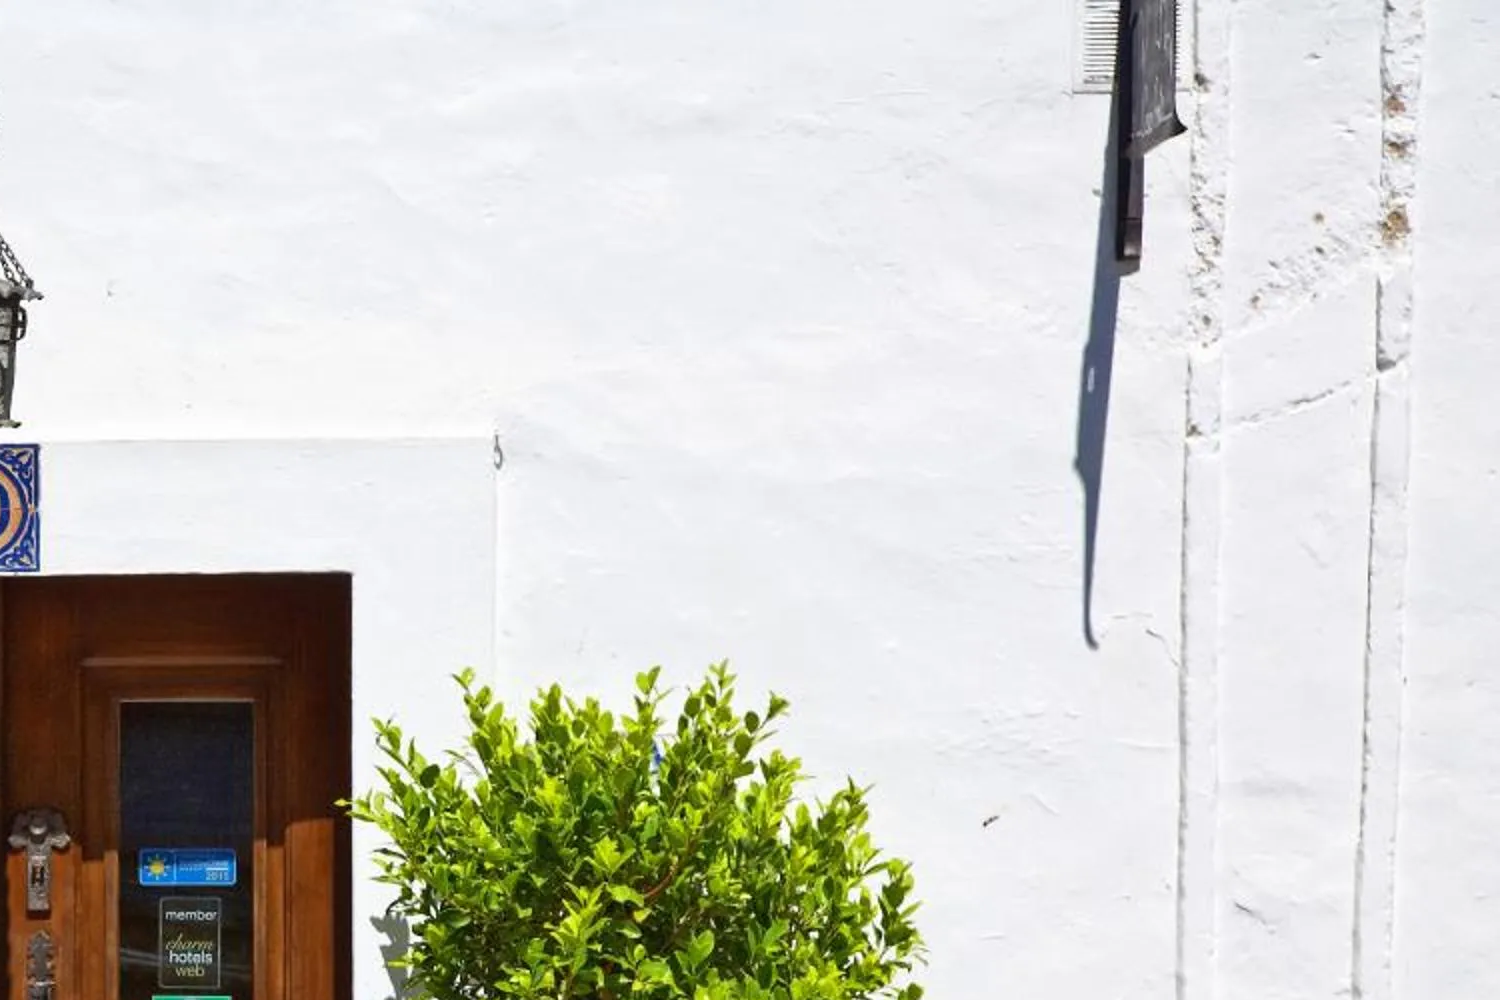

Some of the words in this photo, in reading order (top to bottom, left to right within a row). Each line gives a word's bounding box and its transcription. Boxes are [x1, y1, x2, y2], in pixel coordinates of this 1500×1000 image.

[164, 909, 218, 921] member
[168, 949, 213, 964] hotels
[175, 962, 205, 977] web
